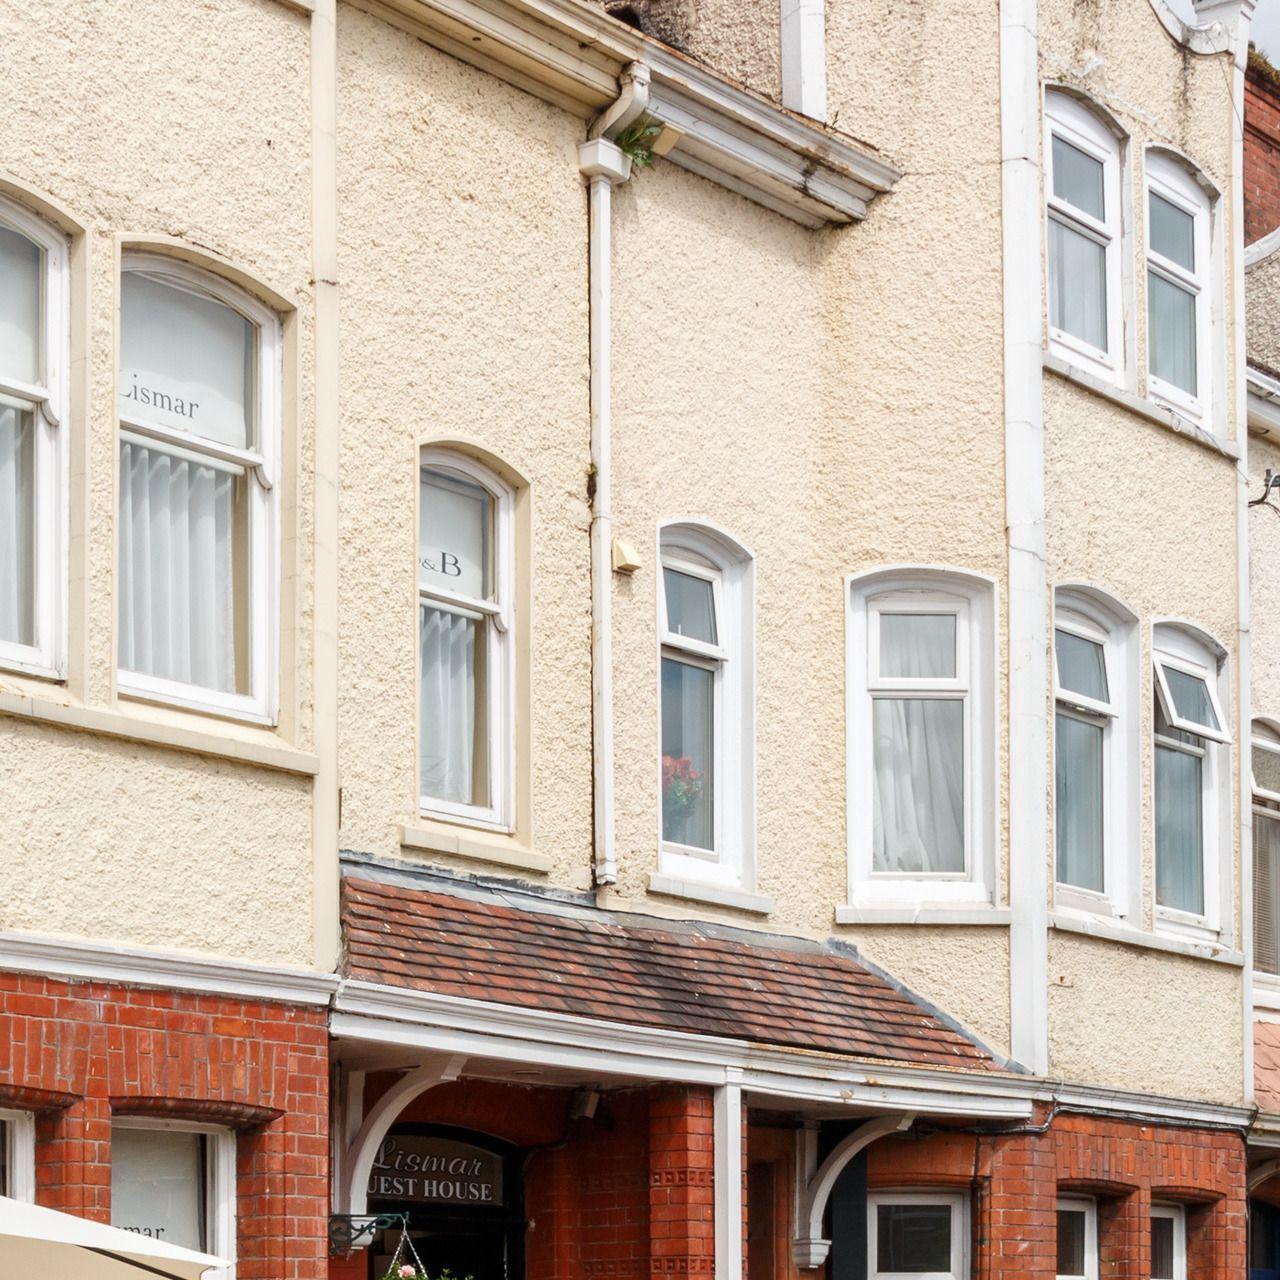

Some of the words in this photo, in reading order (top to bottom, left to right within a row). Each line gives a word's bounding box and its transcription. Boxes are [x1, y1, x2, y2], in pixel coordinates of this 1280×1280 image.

[419, 550, 462, 577] &B
[367, 1174, 418, 1197] UEST
[423, 1178, 494, 1201] HOUSE
